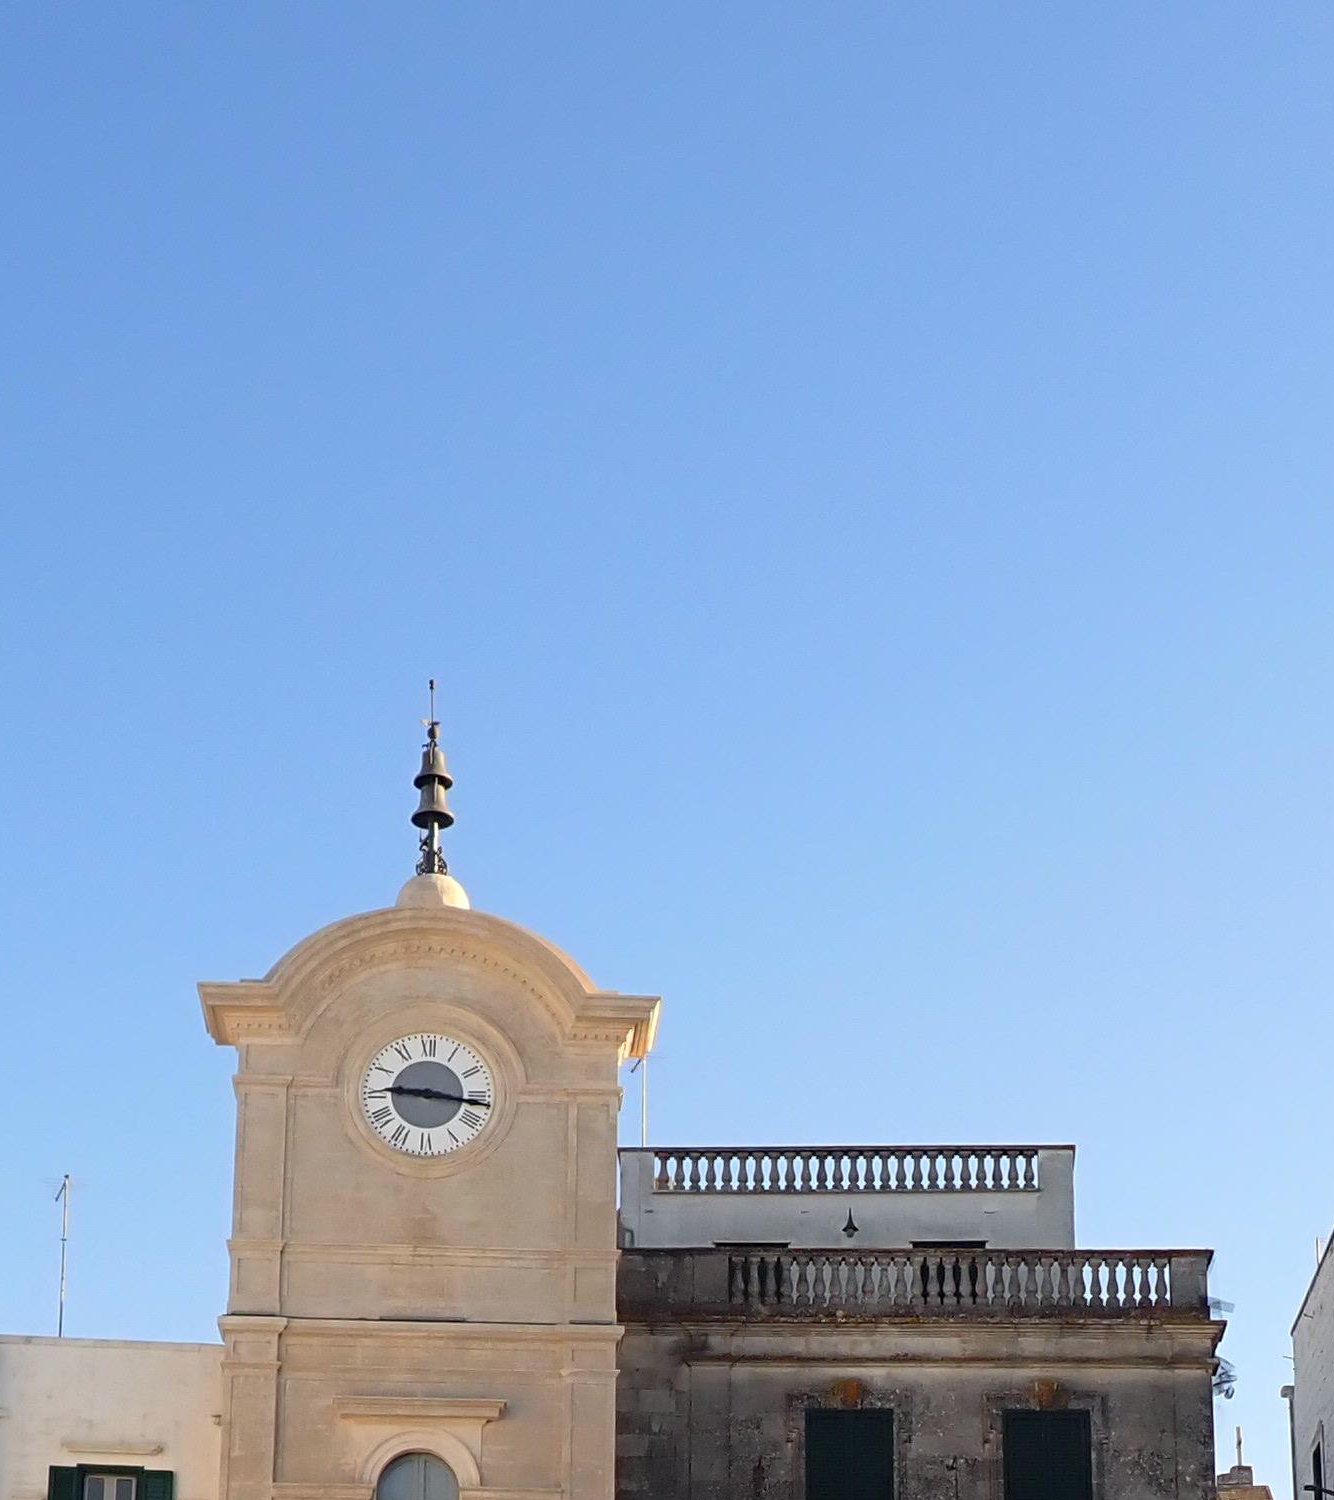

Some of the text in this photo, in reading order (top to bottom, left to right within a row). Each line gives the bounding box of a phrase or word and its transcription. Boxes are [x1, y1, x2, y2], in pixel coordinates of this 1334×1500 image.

[394, 1043, 412, 1062] XI
[421, 1039, 436, 1057] XII
[447, 1047, 459, 1062] I
[375, 1062, 394, 1077] X
[461, 1065, 481, 1079] II
[371, 1105, 395, 1129] VIII
[390, 1124, 411, 1146] VII
[420, 1132, 432, 1151] VI
